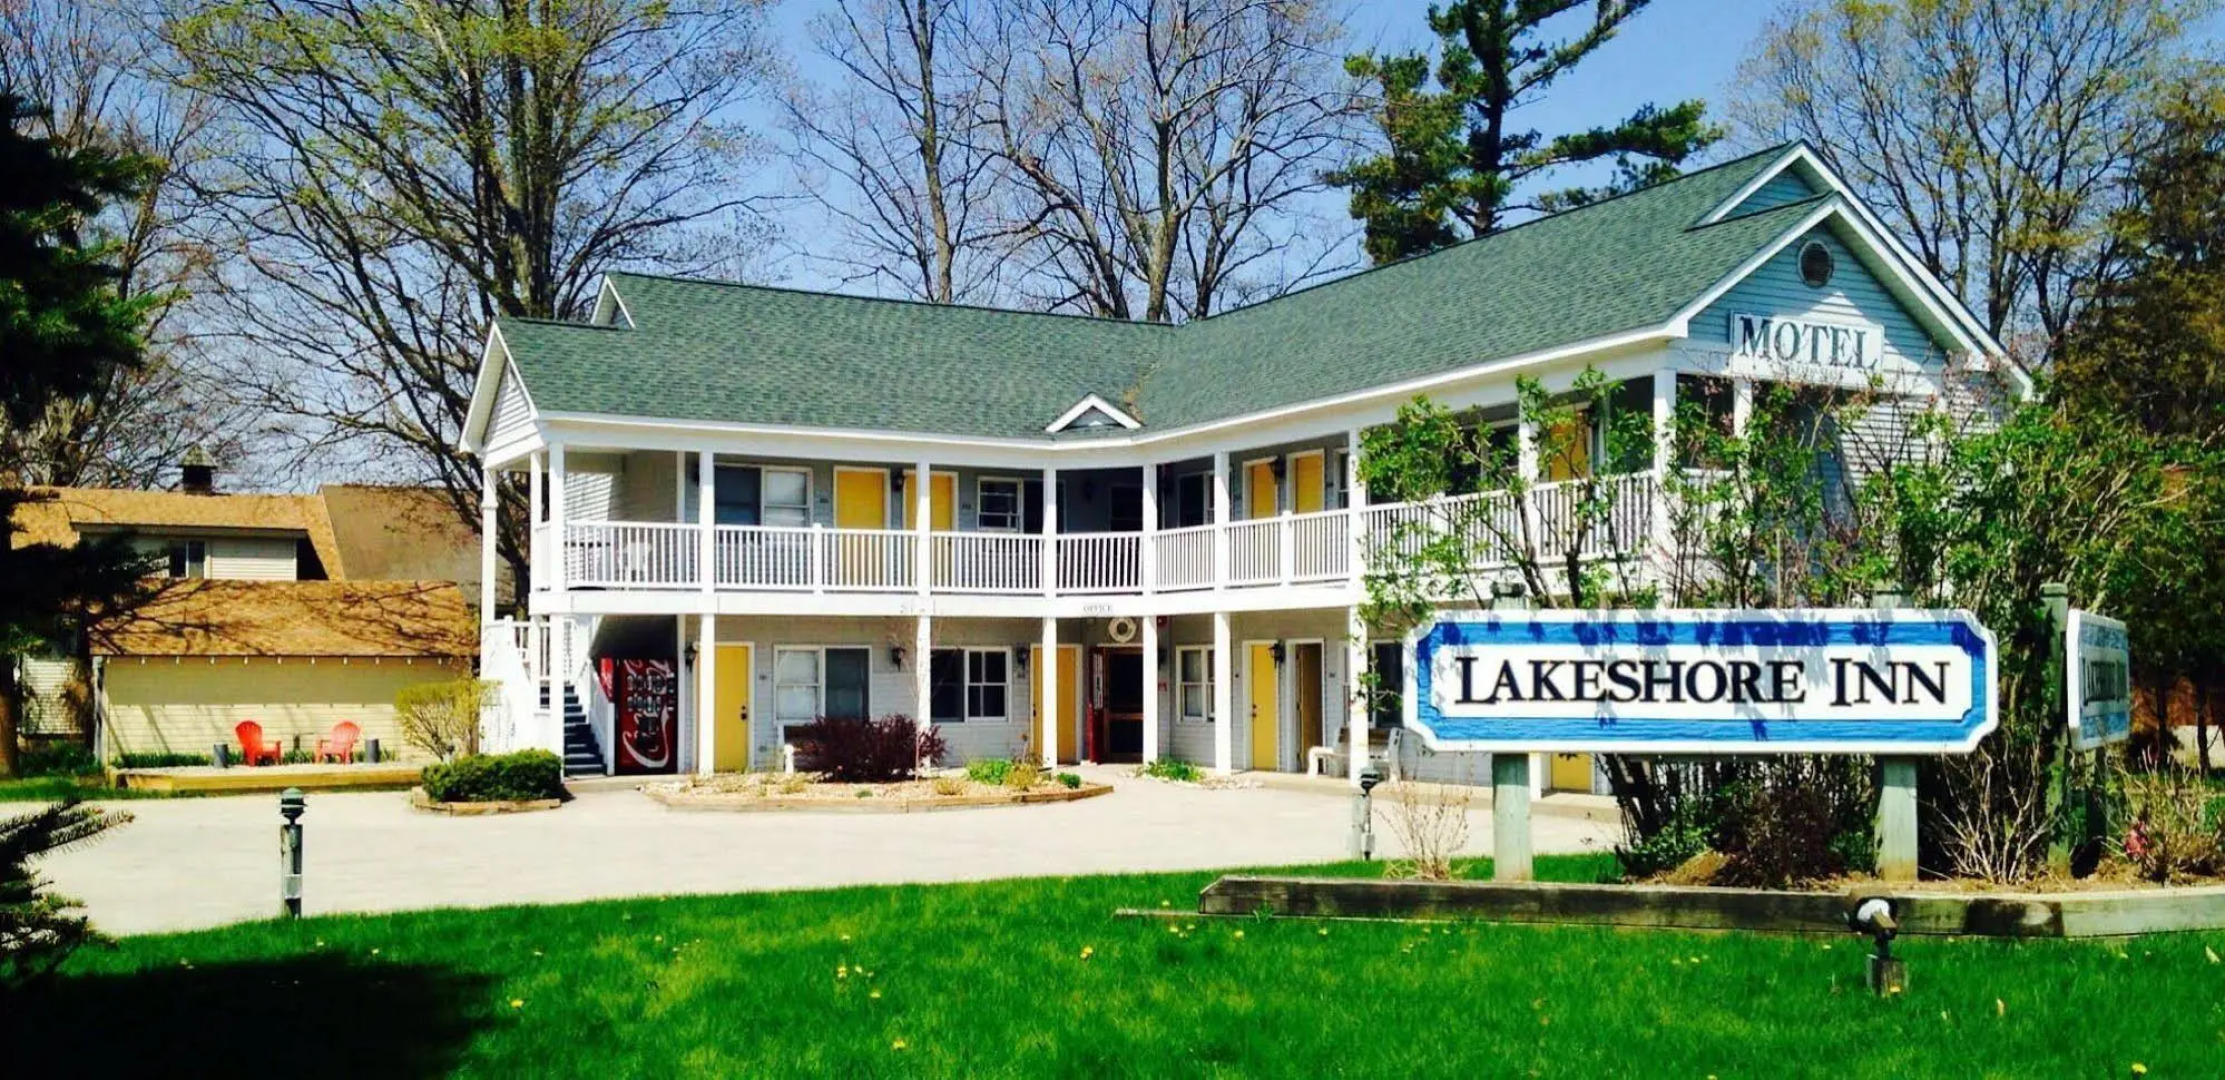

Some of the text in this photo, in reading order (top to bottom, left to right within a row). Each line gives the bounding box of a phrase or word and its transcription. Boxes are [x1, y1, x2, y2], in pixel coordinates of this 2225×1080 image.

[1739, 316, 1878, 370] MOTEL
[1455, 656, 1950, 707] LAKESHORE INN
